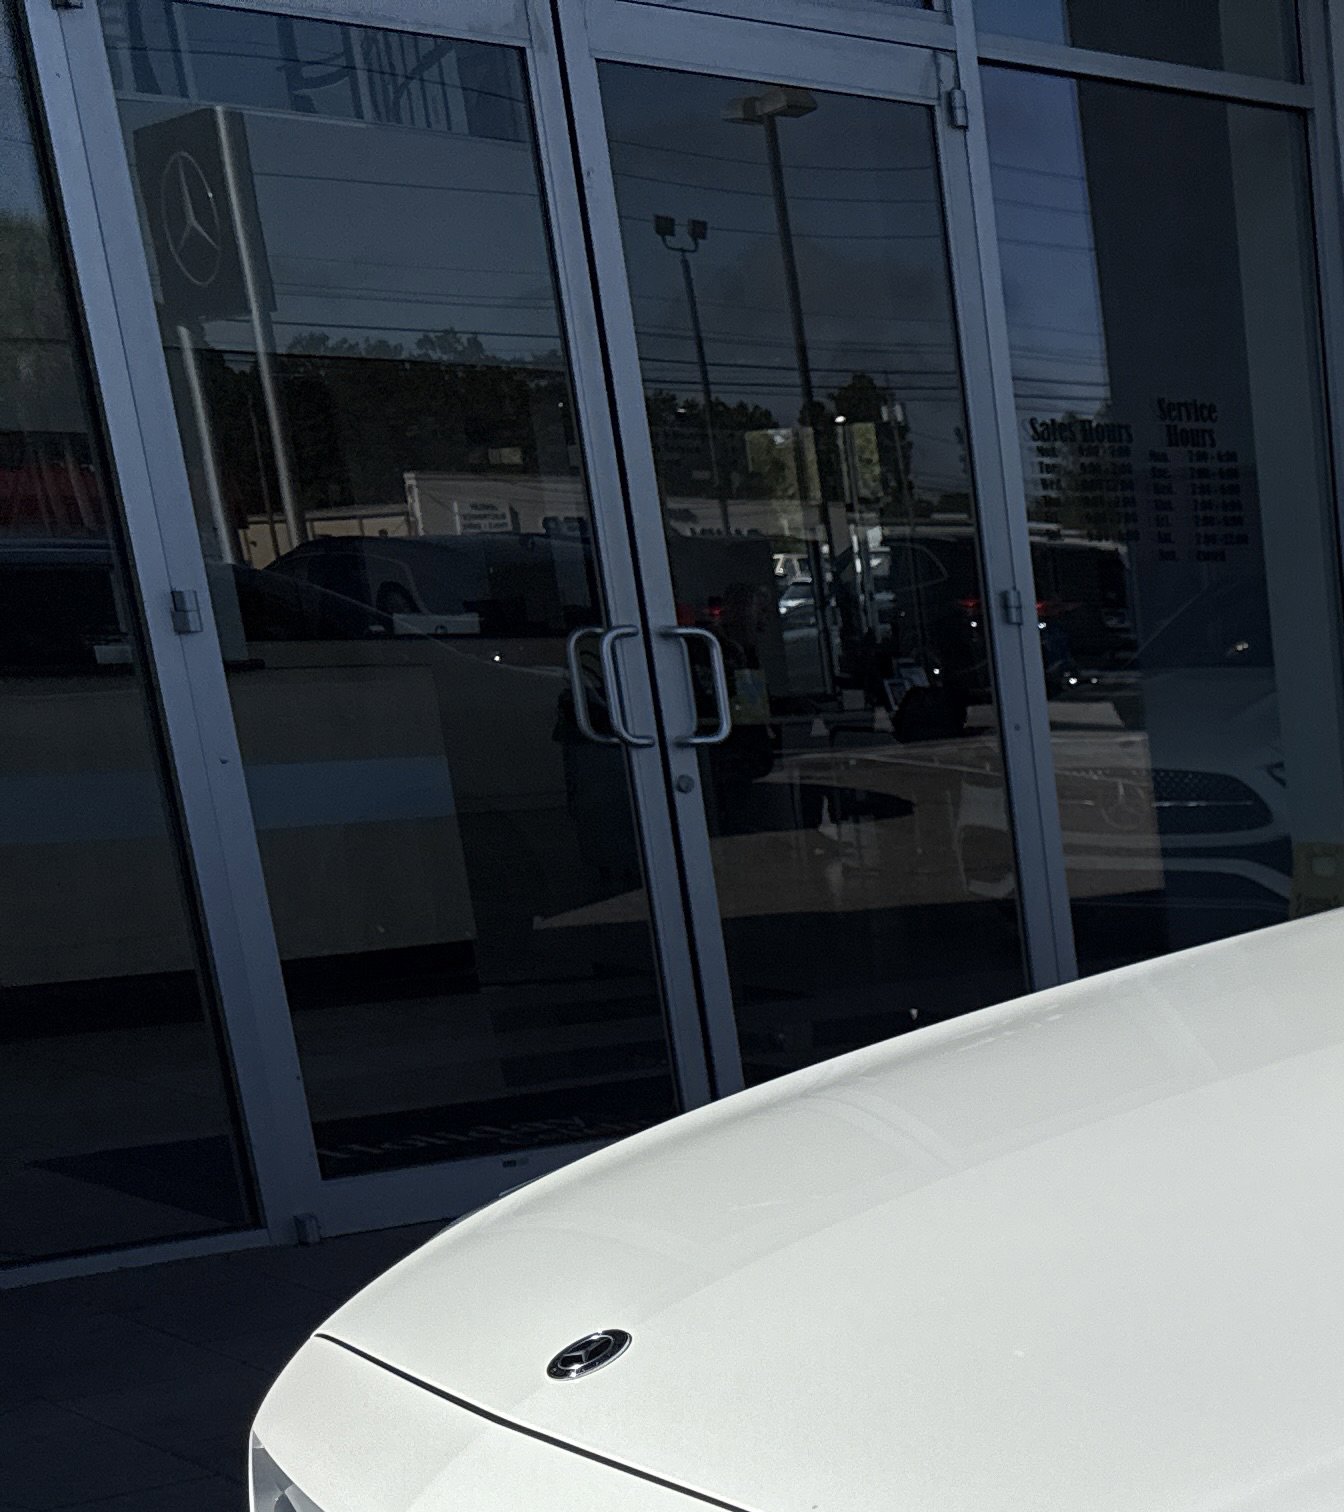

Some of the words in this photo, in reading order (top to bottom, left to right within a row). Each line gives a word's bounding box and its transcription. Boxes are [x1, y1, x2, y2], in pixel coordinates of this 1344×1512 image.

[1157, 398, 1218, 423] Service
[1029, 417, 1076, 443] Sales
[1165, 424, 1217, 448] Hours
